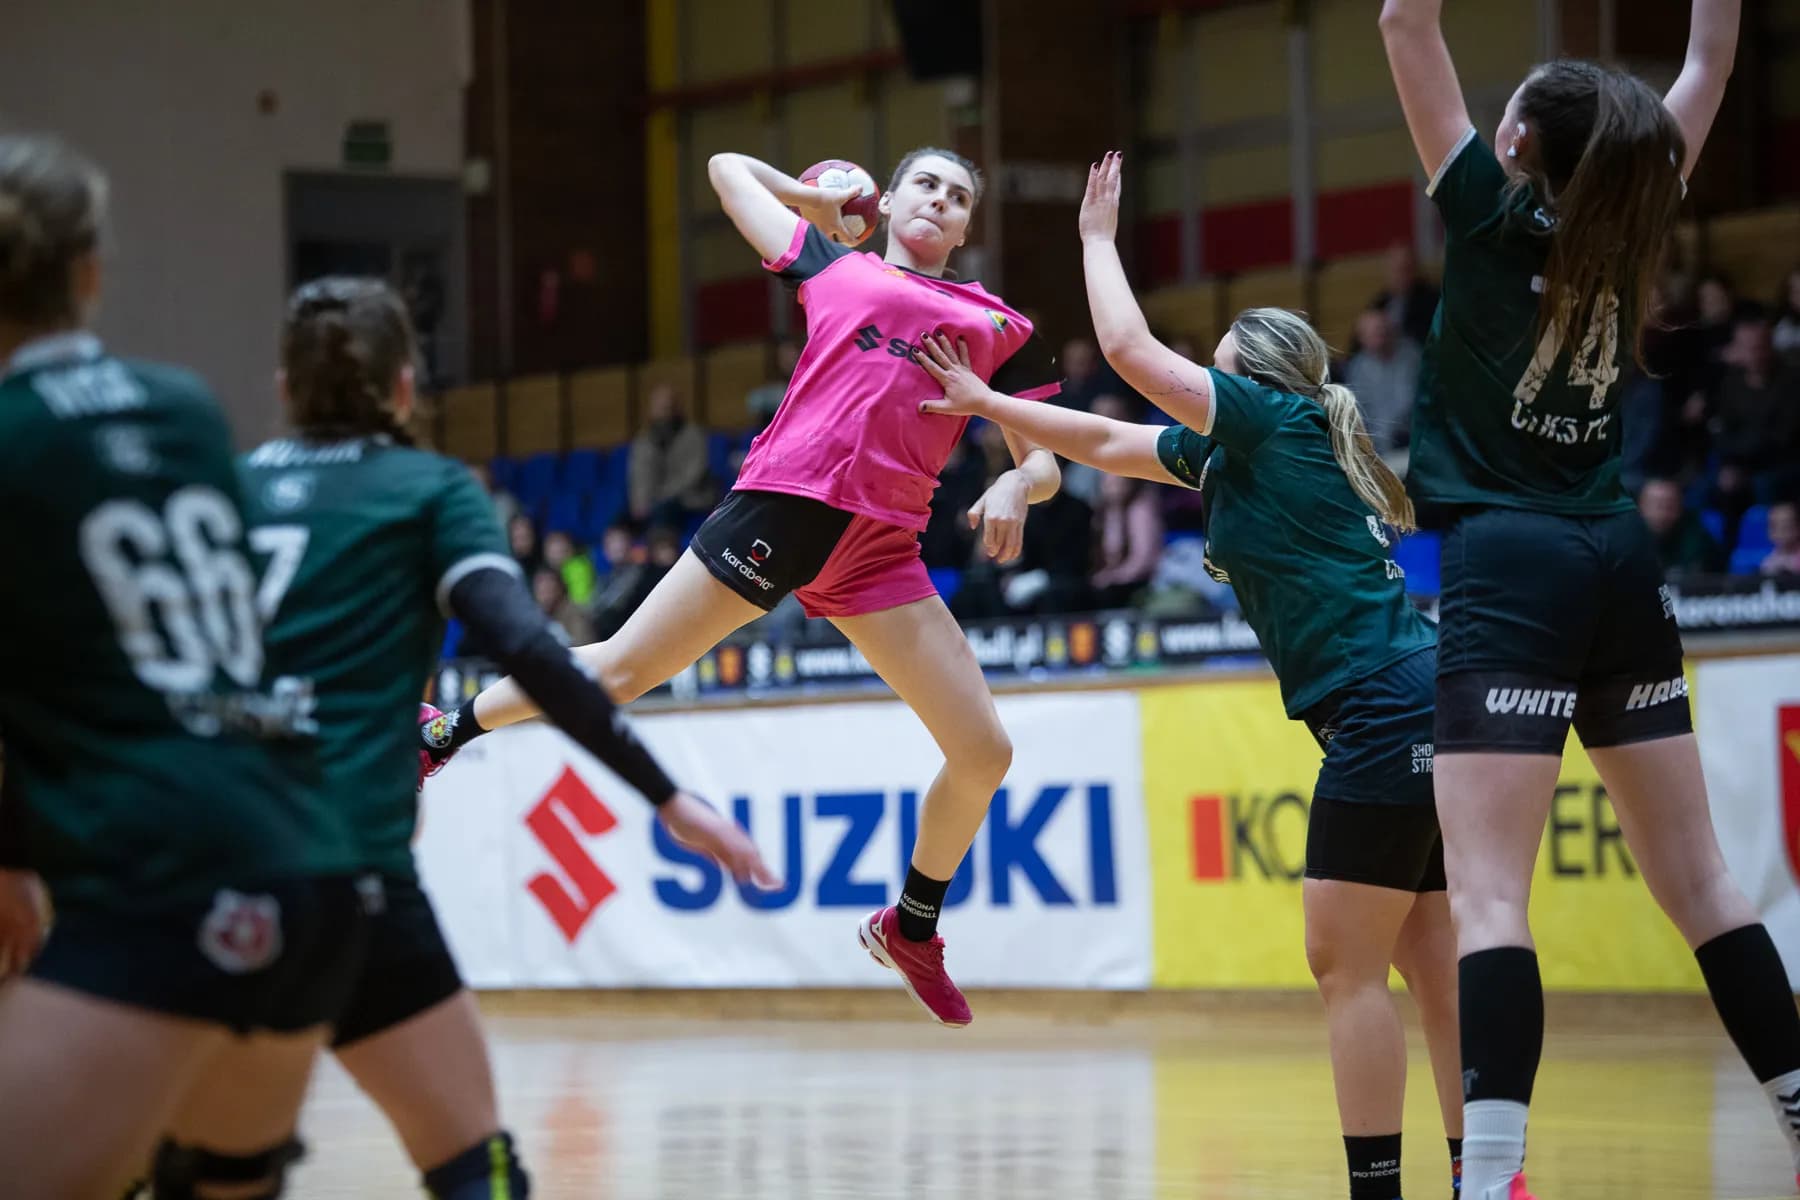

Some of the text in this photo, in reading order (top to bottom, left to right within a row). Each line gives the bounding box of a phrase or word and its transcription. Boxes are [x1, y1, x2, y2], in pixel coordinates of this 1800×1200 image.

[79, 484, 264, 692] 66
[1485, 687, 1578, 718] WHITE
[903, 892, 935, 911] KORONA
[1371, 1160, 1396, 1169] MKS
